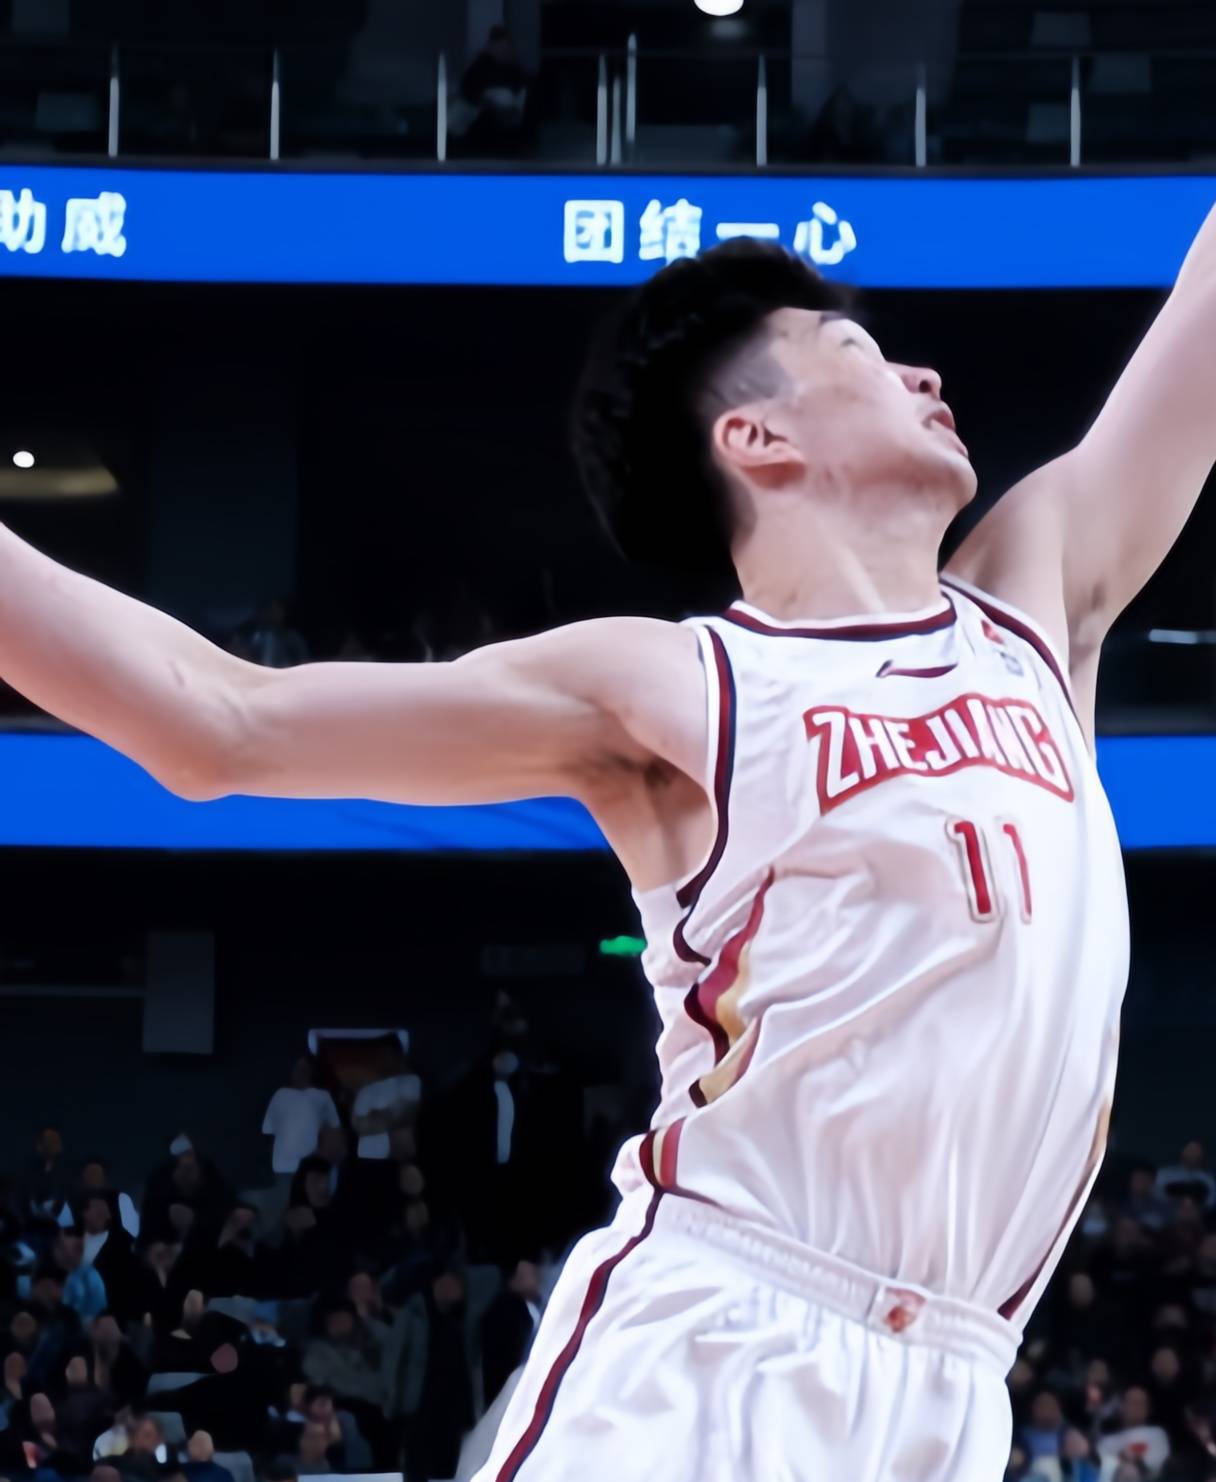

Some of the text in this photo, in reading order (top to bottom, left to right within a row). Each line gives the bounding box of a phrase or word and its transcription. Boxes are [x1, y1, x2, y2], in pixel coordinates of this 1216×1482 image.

[563, 198, 857, 266] 团结一心
[805, 695, 1073, 808] ZHEJIANG
[947, 818, 1032, 923] 11
